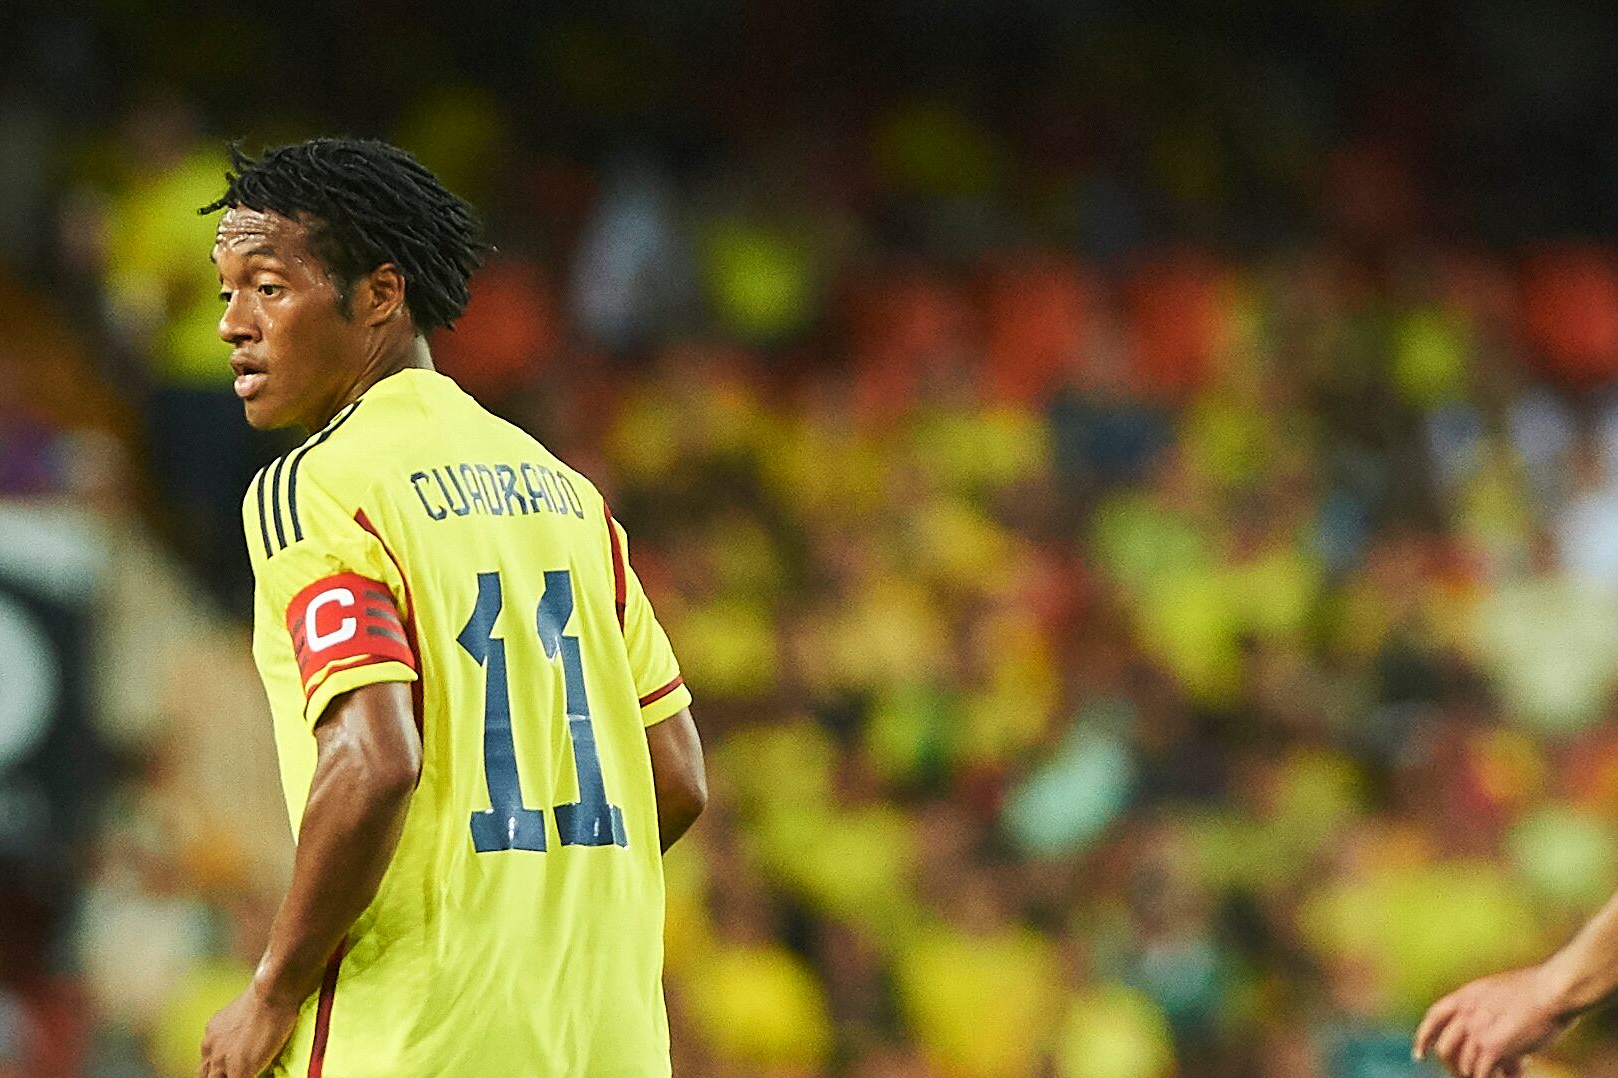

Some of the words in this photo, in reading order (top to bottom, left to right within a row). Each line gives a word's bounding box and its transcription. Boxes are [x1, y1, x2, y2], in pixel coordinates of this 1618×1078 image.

[410, 462, 584, 521] CUADRADO
[304, 588, 357, 653] C
[456, 569, 627, 853] 11
